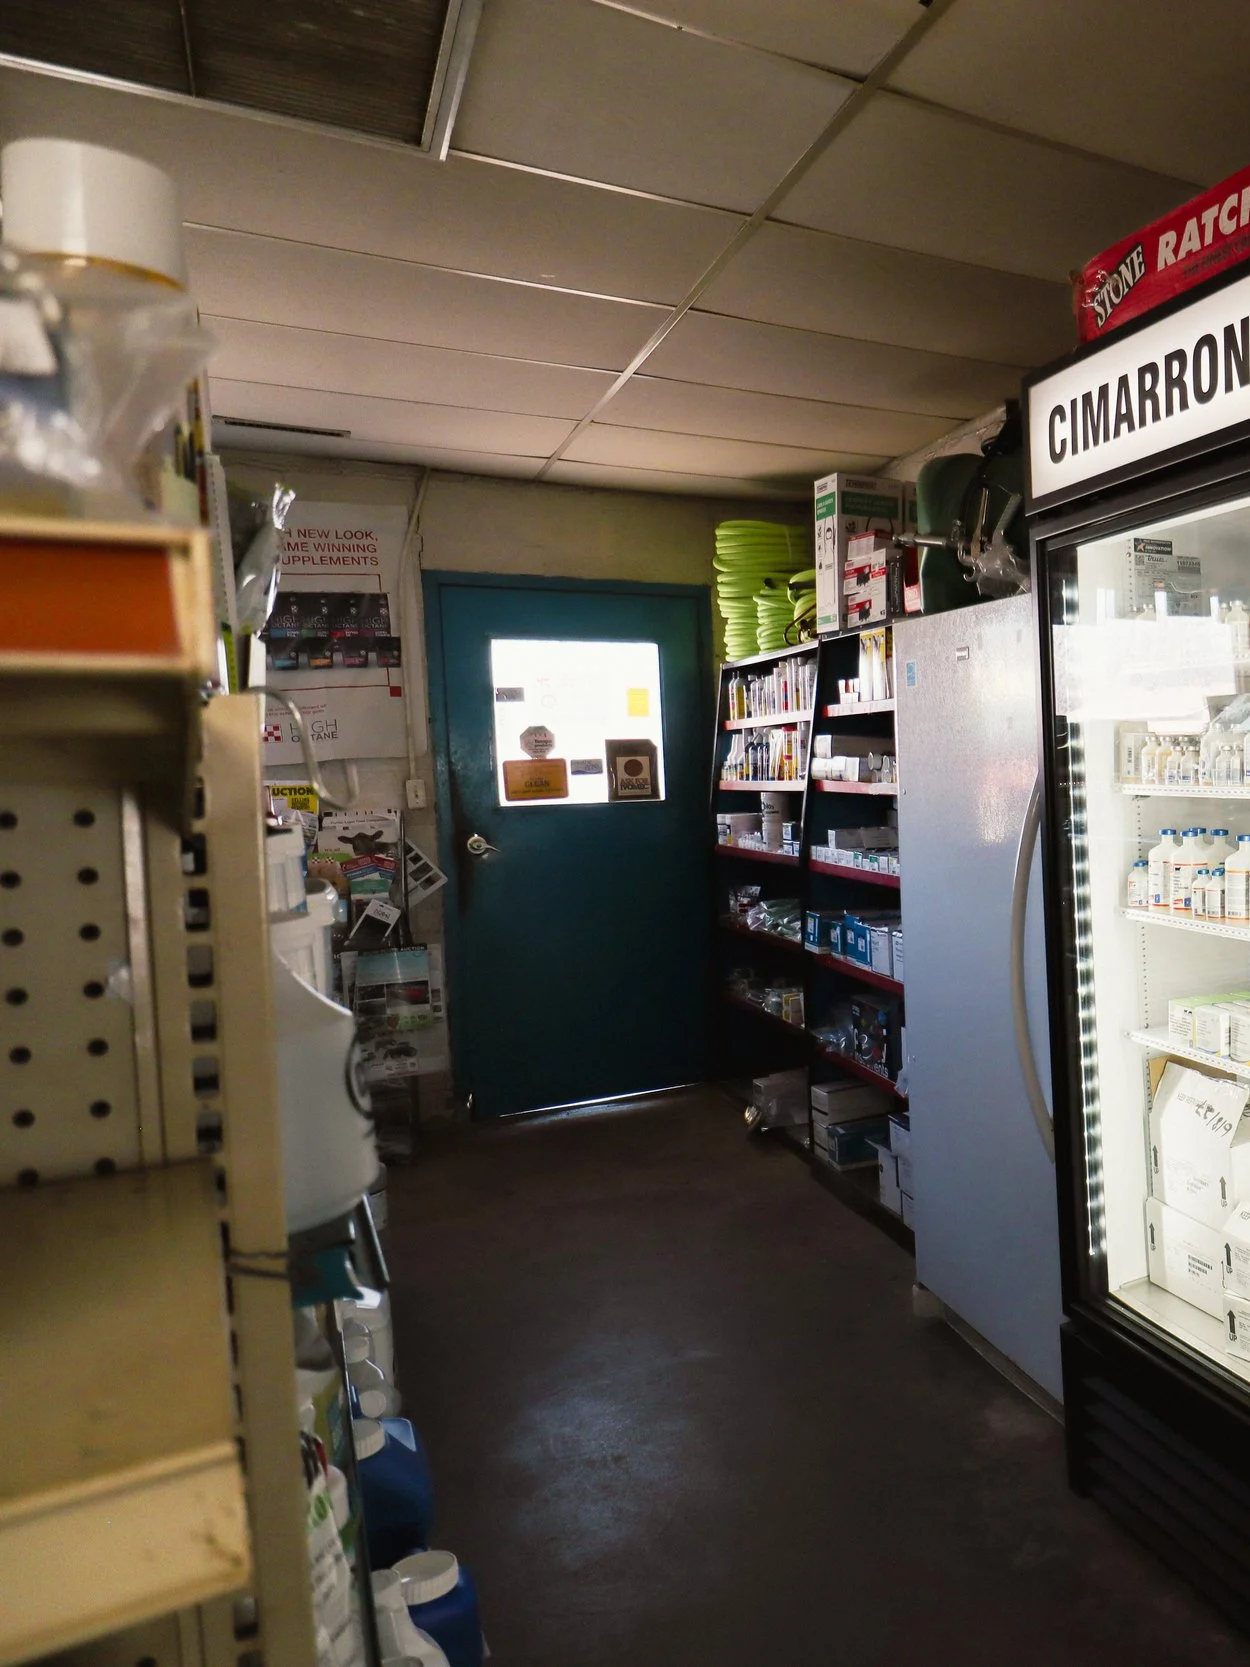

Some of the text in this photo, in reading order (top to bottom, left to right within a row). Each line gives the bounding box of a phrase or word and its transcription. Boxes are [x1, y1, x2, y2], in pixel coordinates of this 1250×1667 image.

[1093, 243, 1146, 329] STONE
[1048, 314, 1250, 466] CIMARRON
[297, 528, 379, 542] NEW LOOK,
[313, 542, 377, 554] WINNING
[289, 719, 338, 735] HGH
[291, 731, 339, 743] OTANE
[620, 777, 649, 785] ASK FOR
[1226, 1266, 1234, 1274] UP
[1228, 1333, 1238, 1342] UP
